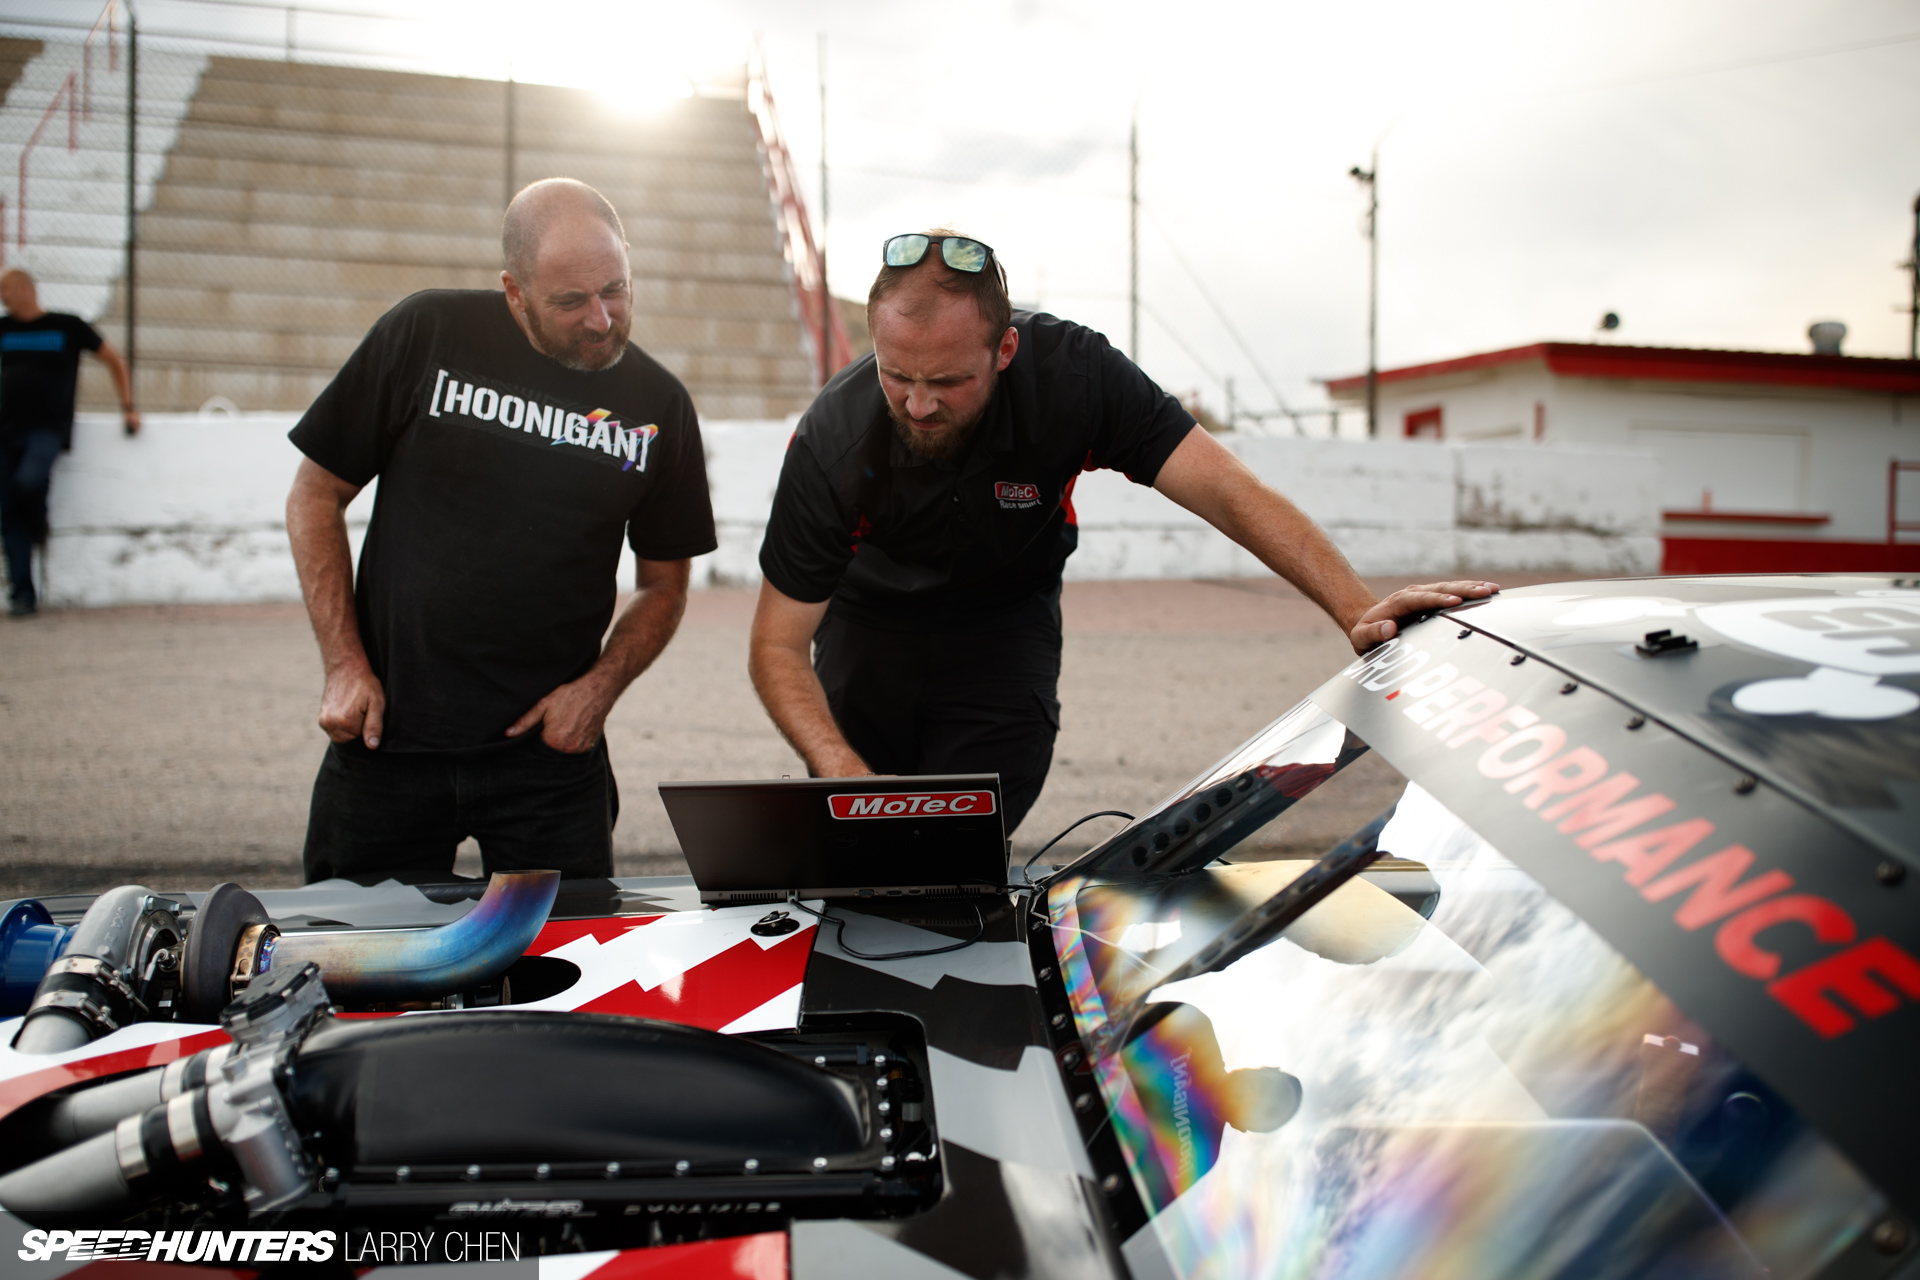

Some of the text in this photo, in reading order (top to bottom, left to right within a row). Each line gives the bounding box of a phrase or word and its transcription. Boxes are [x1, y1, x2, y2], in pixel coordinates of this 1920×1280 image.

[1001, 484, 1033, 499] MoTeC
[848, 794, 978, 816] MoTeC
[1342, 637, 1920, 1041] ORD PERFORMANCE
